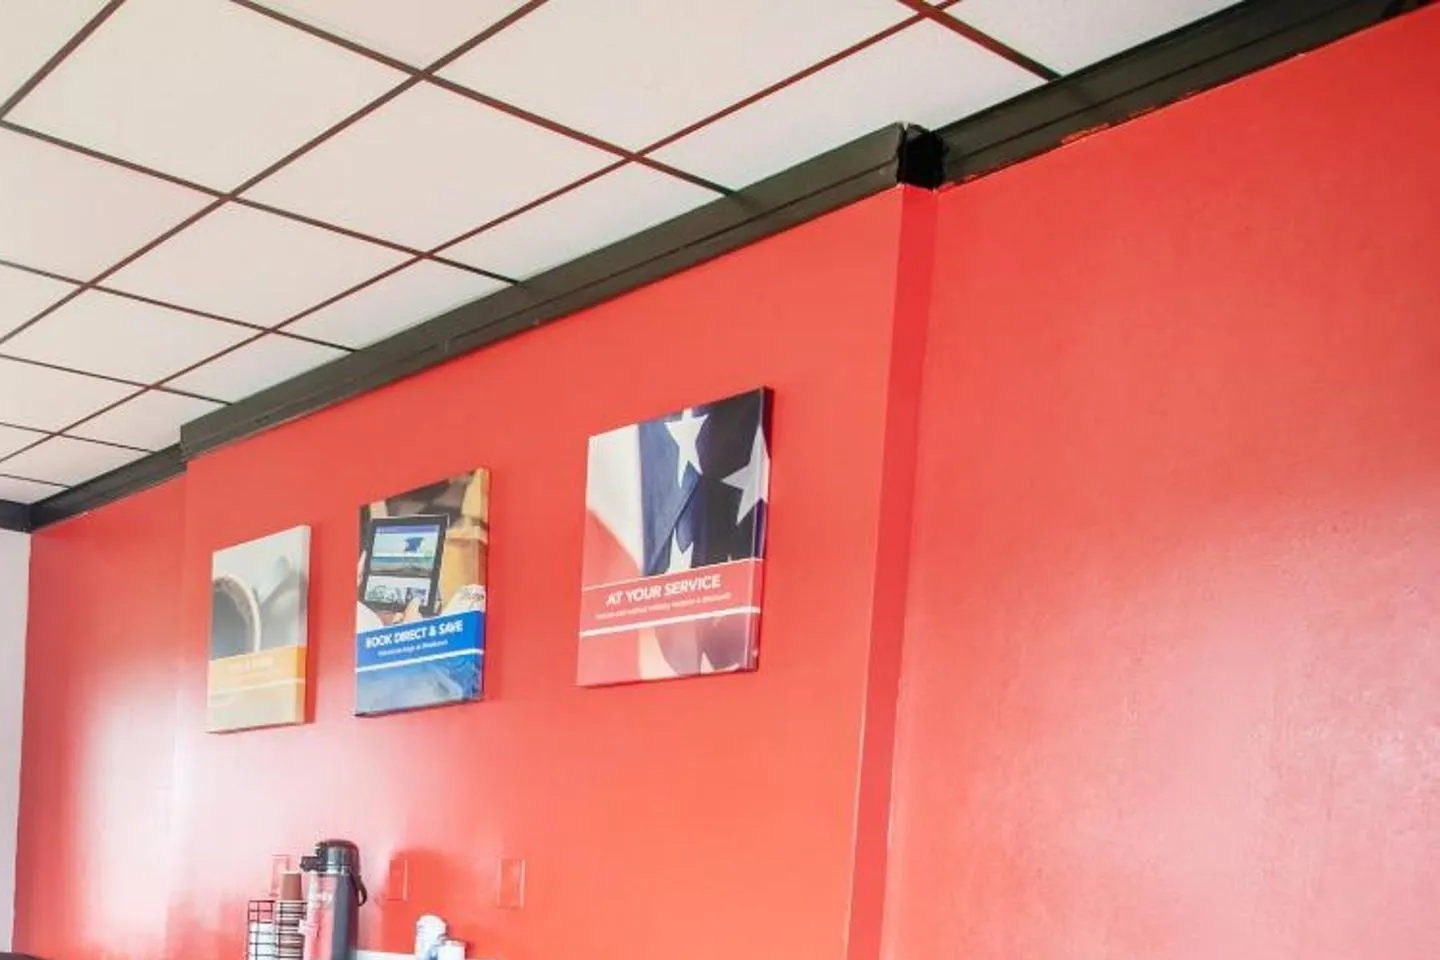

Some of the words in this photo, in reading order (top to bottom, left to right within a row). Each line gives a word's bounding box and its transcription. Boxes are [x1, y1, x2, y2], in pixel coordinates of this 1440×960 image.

[606, 591, 622, 606] AT
[625, 584, 662, 603] YOUR
[664, 574, 721, 595] SERVICE
[365, 634, 392, 648] BOOK
[394, 627, 427, 643] DIRECT
[429, 625, 437, 636] &
[438, 620, 464, 634] SAVE
